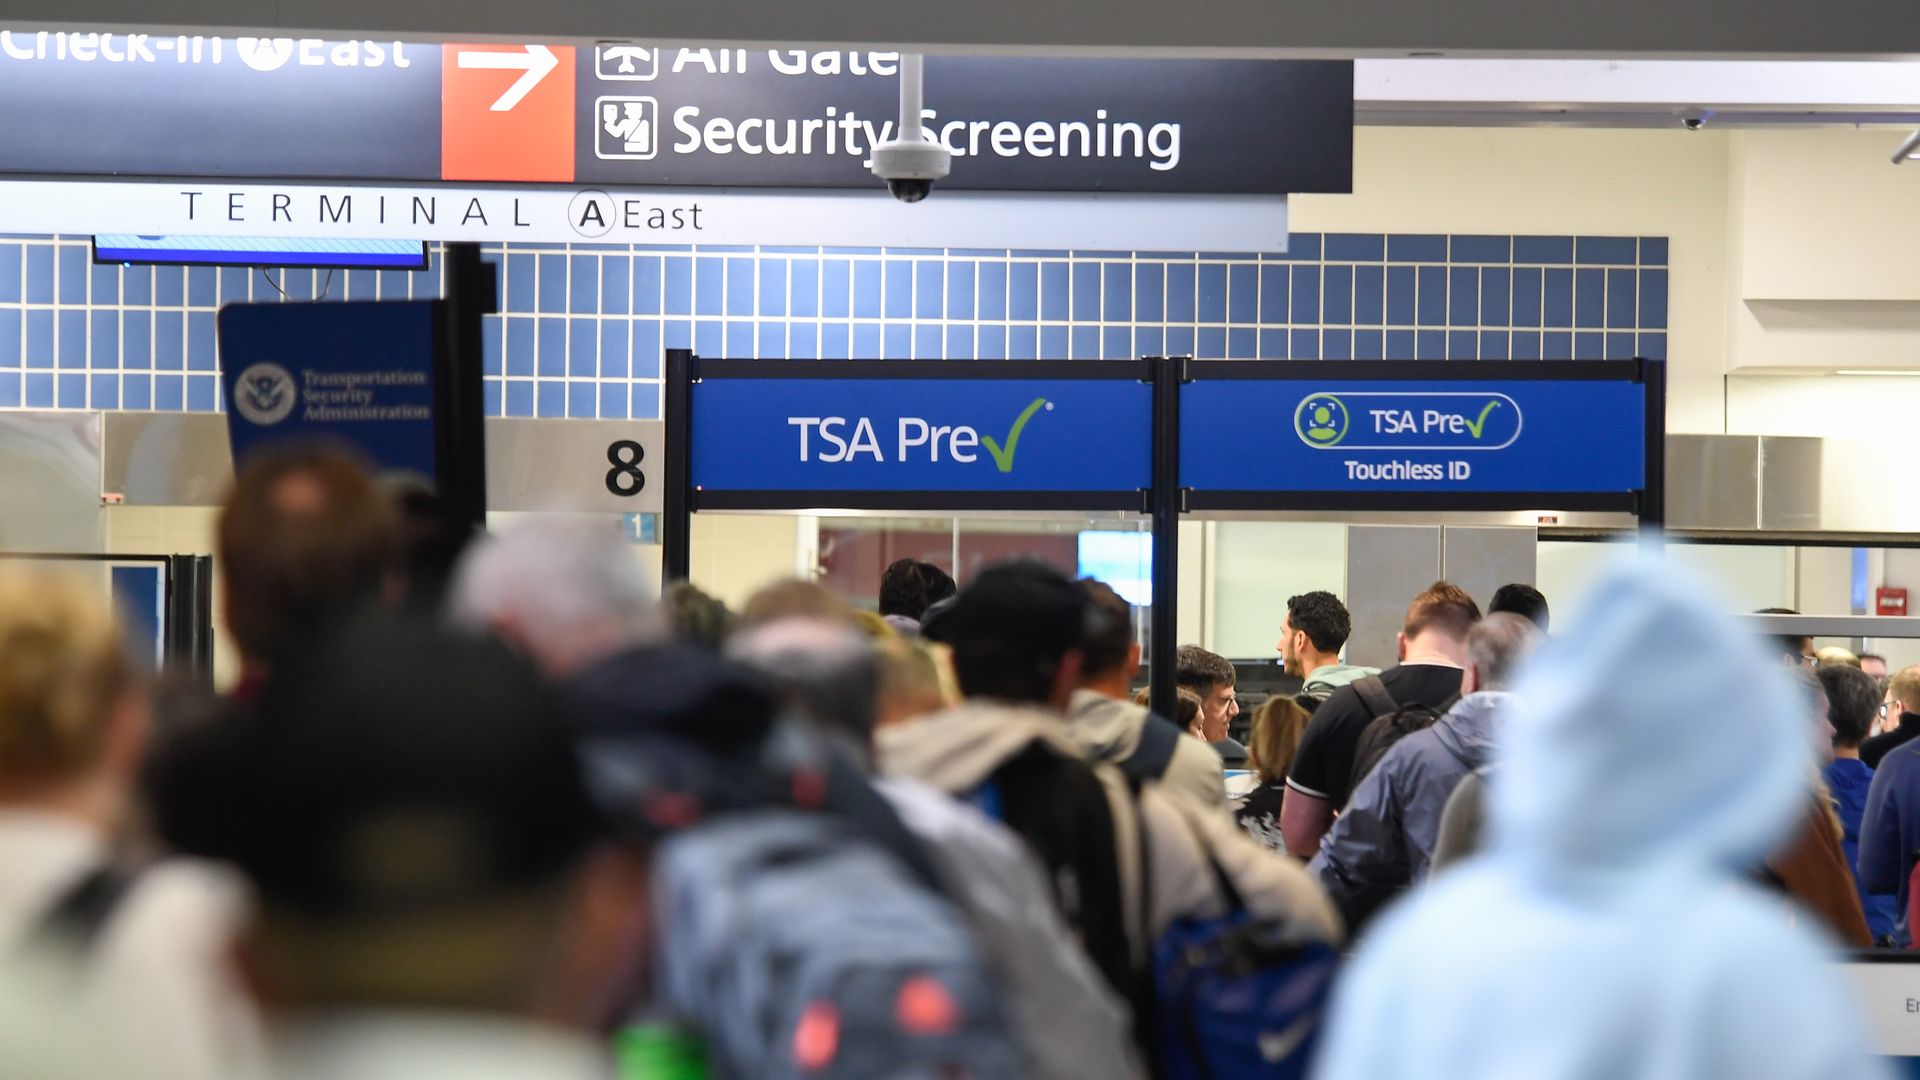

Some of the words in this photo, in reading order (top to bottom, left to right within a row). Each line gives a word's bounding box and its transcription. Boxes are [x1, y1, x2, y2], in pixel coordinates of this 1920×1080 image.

[299, 38, 410, 67] East
[673, 106, 894, 168] Security
[181, 192, 530, 227] TERMINAL
[624, 200, 703, 229] East
[303, 371, 426, 388] Transportation
[303, 390, 373, 404] Security
[303, 405, 429, 420] Administration
[1369, 409, 1417, 434] TSA
[788, 416, 884, 462] TSA
[605, 439, 645, 497] 8
[1344, 460, 1444, 481] Touchless
[1448, 461, 1471, 481] ID
